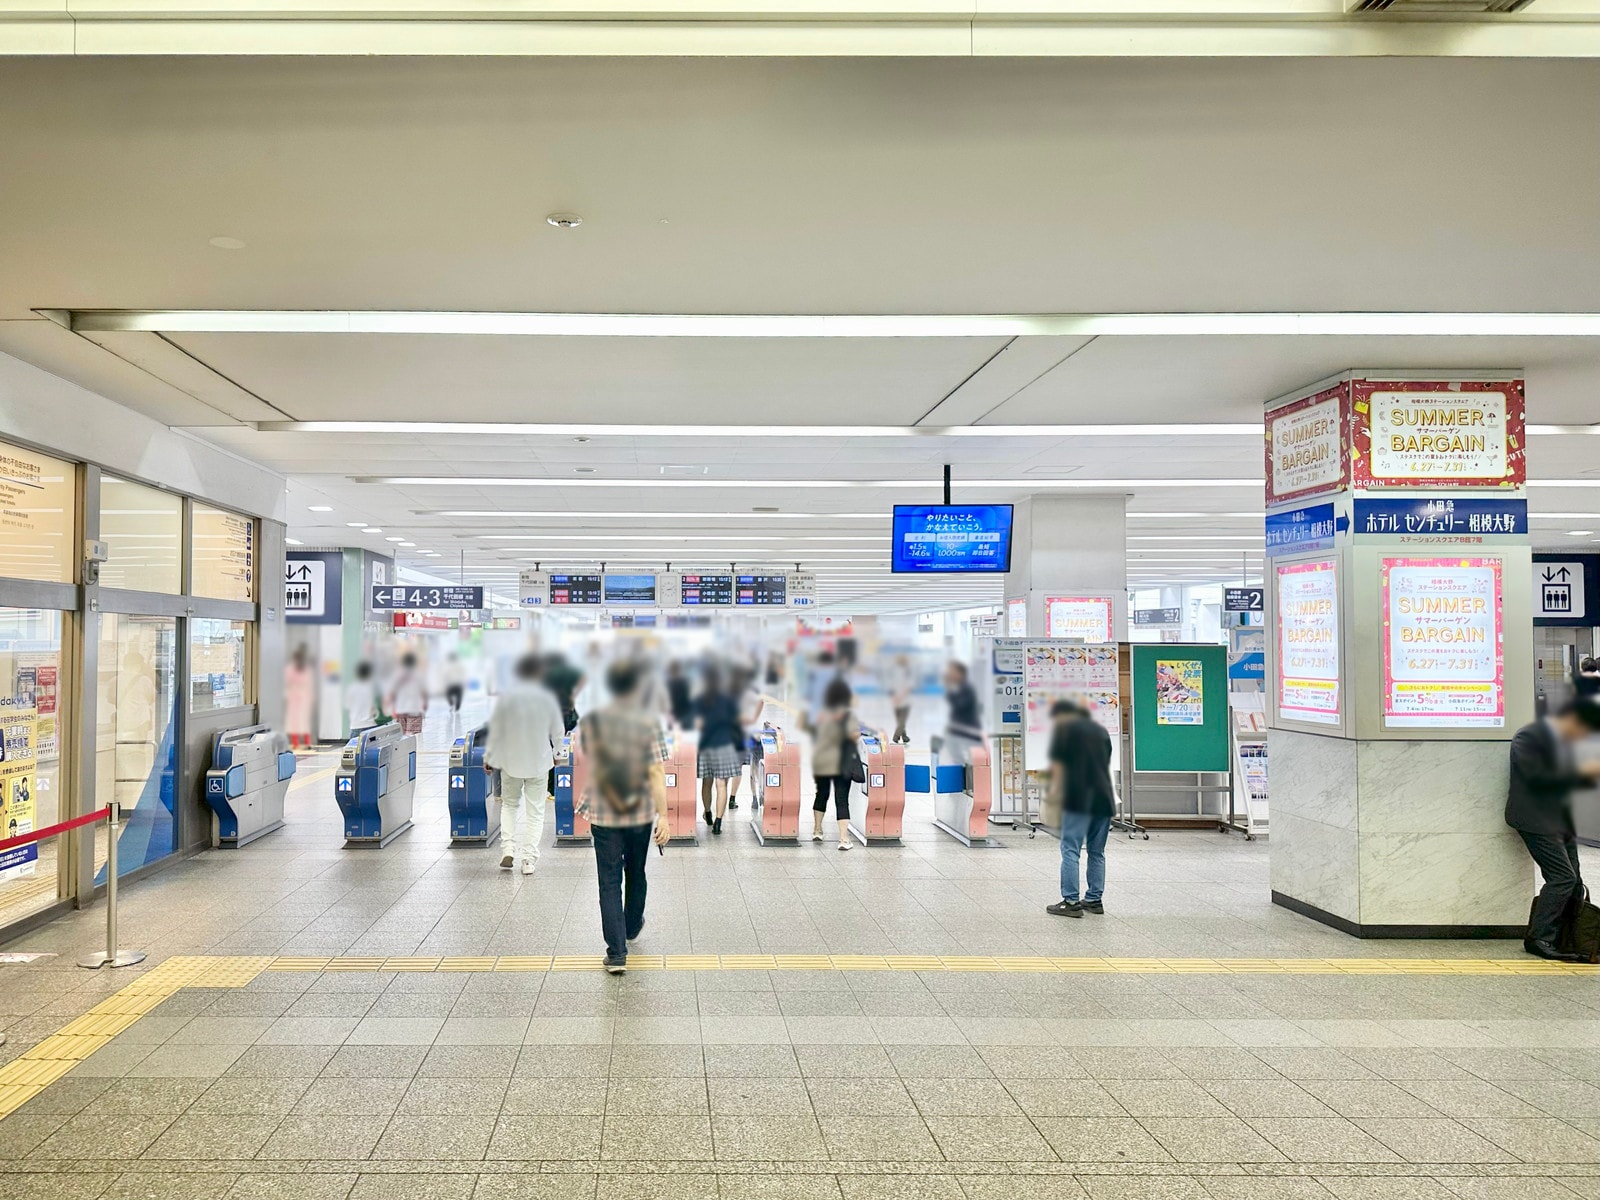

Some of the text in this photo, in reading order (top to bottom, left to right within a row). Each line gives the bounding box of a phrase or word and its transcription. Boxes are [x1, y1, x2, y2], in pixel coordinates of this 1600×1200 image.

[1391, 409, 1485, 426] SUMMER
[1281, 418, 1329, 447] SUMMER
[1391, 435, 1485, 452] BARGAIN
[1282, 442, 1329, 471] BARGAIN
[1427, 500, 1455, 513] 小田急
[926, 513, 977, 522] やりたいこと、
[1366, 514, 1516, 533] ホテル センチュリー 相模大野
[926, 523, 983, 531] かなえていこう。
[1311, 519, 1334, 539] 相模大野
[1249, 591, 1262, 608] 2
[1398, 597, 1487, 614] SUMMER
[1134, 611, 1138, 623] 1
[1174, 609, 1179, 622] 2
[1286, 600, 1333, 616] SUMMER
[1055, 619, 1103, 628] SUMMER
[1415, 617, 1471, 625] サマーバーゲン
[1287, 628, 1333, 643] BARGAIN
[1401, 627, 1485, 643] BARGAIN
[768, 775, 779, 785] IC
[871, 775, 883, 785] IC
